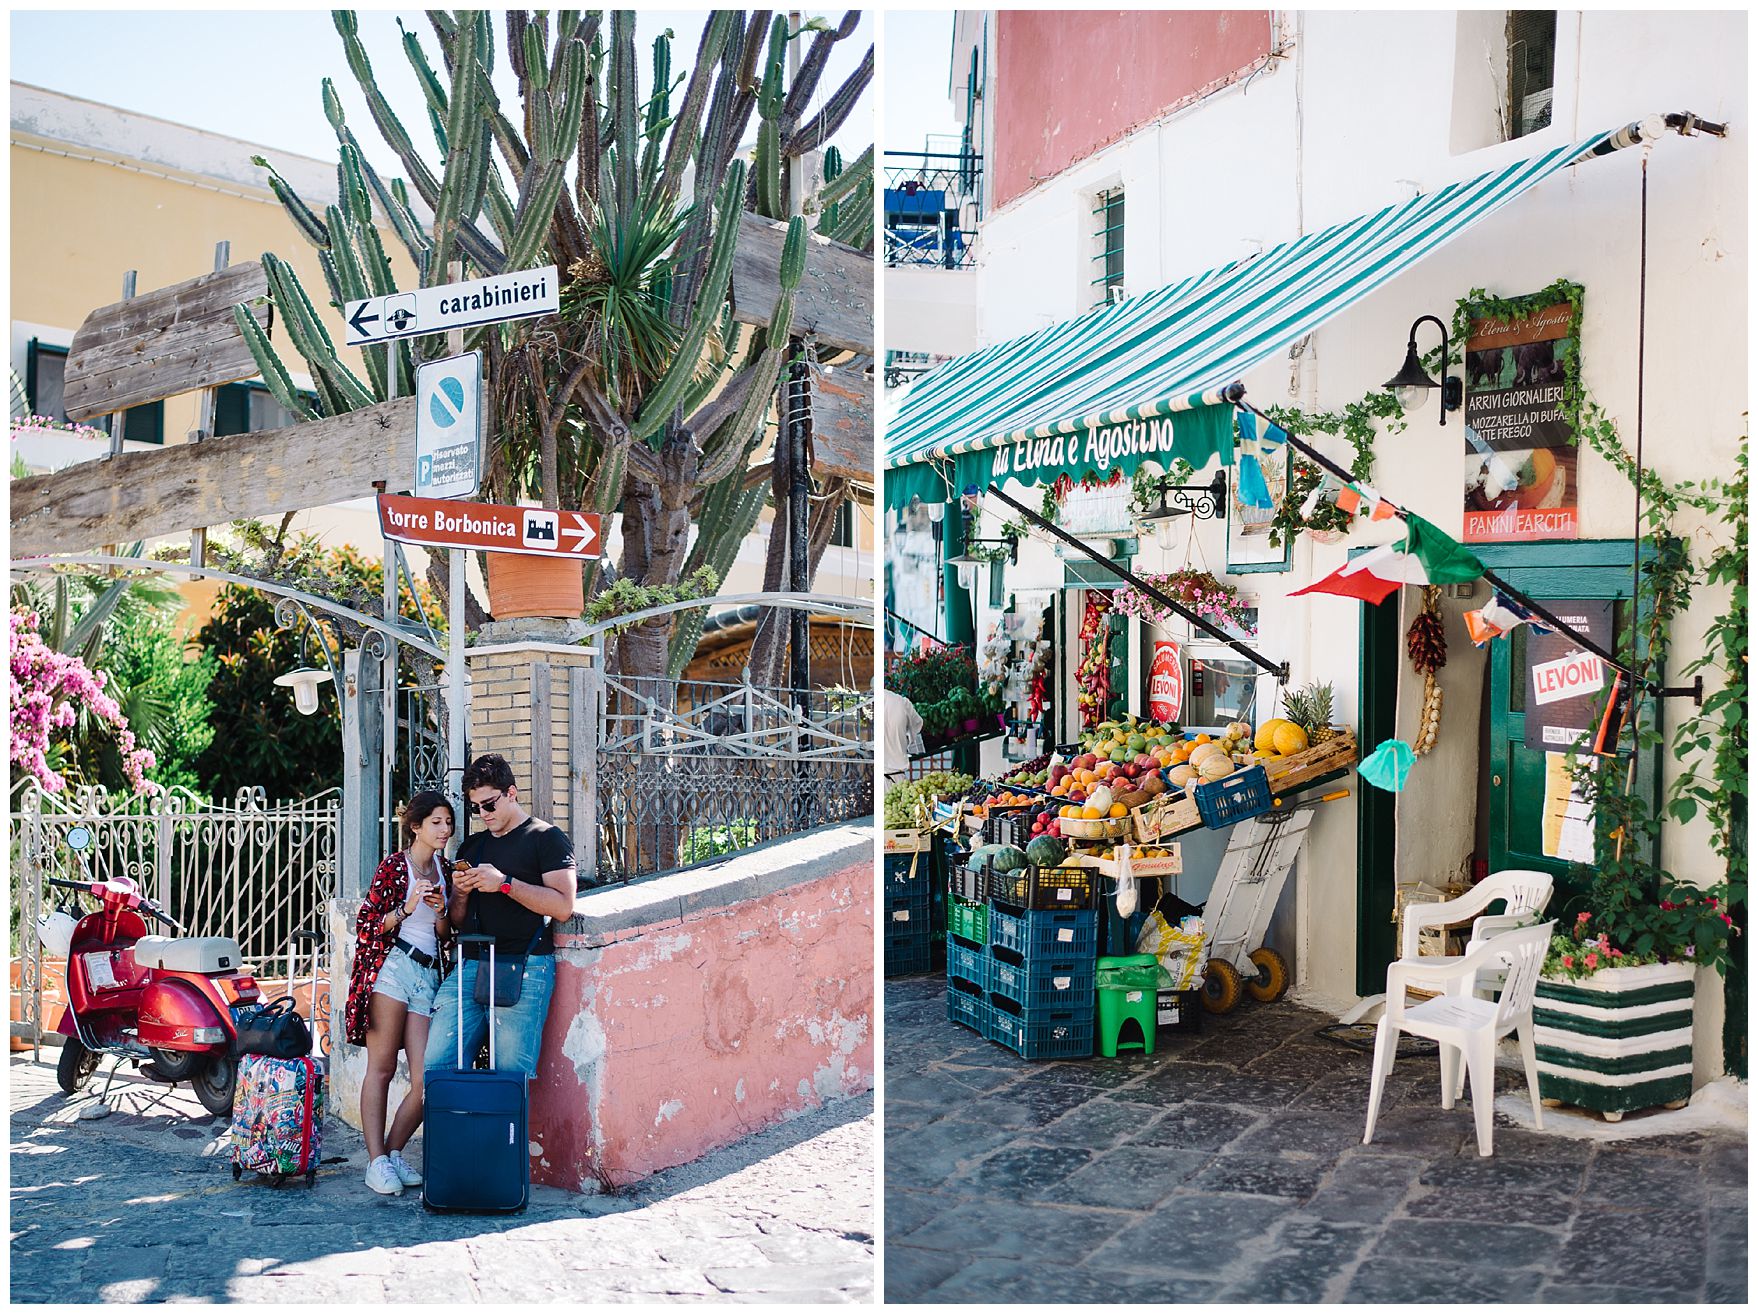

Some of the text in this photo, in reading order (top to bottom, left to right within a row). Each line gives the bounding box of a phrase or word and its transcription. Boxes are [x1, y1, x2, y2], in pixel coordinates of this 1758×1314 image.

[440, 277, 546, 315] carabinieri
[1480, 319, 1511, 337] Elena
[1526, 311, 1573, 340] Agostin
[1468, 395, 1501, 411] ARRIVI
[1502, 386, 1564, 408] GIORNALIERI
[1472, 413, 1529, 429] MOZZARELLA
[1530, 411, 1540, 424] DI
[1473, 425, 1532, 442] LATTE FRESCO
[433, 444, 469, 460] riservato
[992, 445, 1010, 477] da
[1067, 435, 1079, 465] e
[1084, 418, 1174, 470] Agostino
[421, 461, 430, 482] P
[433, 459, 455, 472] mezzi
[433, 468, 474, 486] autorizzati
[387, 506, 516, 537] torre Borbonica
[1470, 513, 1571, 535] PANINI FARCITI
[1535, 657, 1600, 694] LEVONI
[1152, 679, 1176, 698] LEVONI
